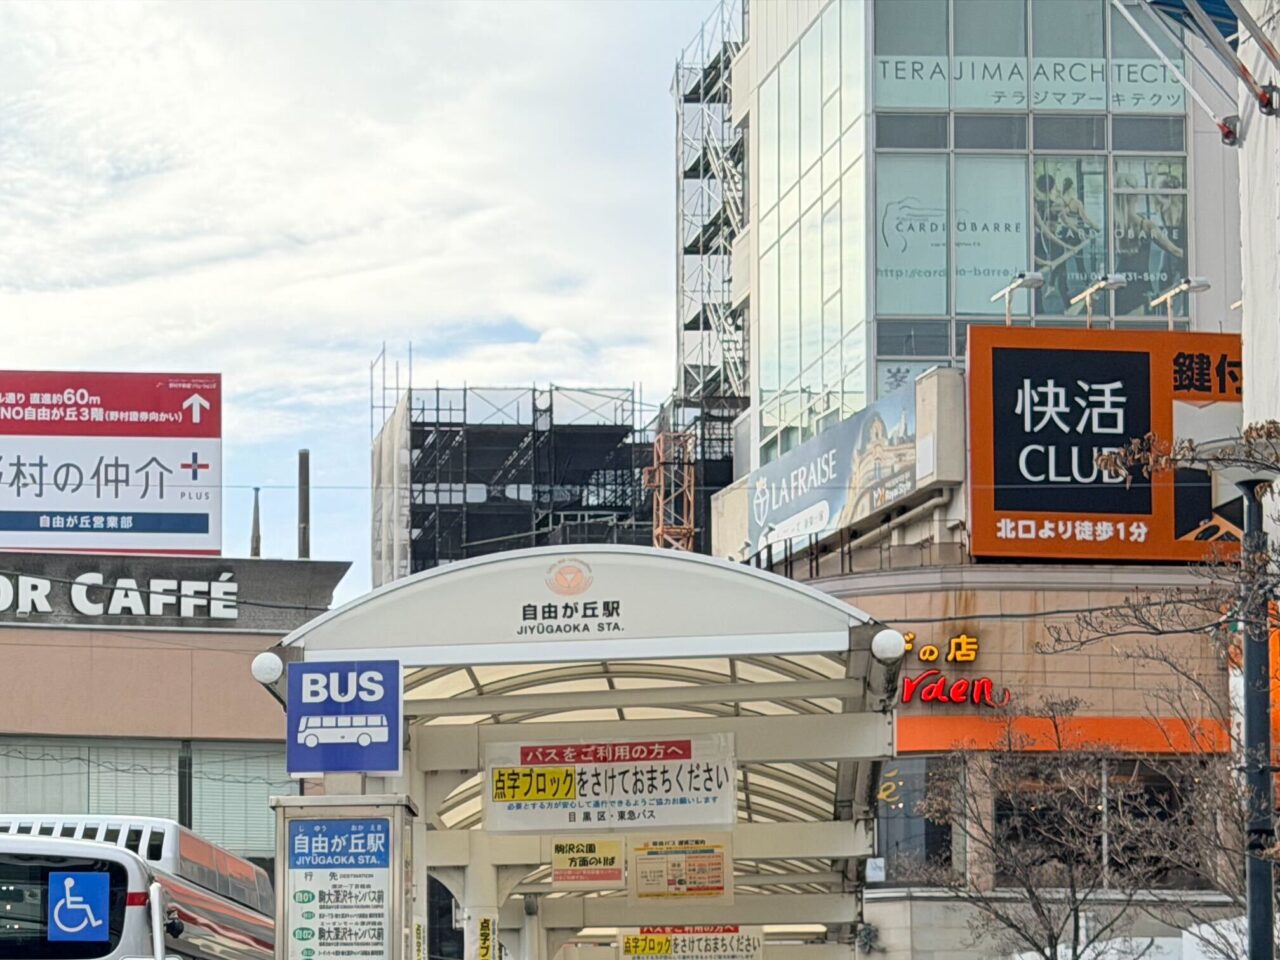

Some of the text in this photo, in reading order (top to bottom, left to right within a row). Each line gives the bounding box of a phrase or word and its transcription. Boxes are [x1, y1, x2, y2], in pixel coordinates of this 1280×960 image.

[880, 60, 1181, 84] TERAJIMA ARCHTECTS
[992, 90, 1181, 106] テラジマアーキテクツ
[30, 388, 101, 405] 直進約60m
[1014, 378, 1127, 434] 快活
[790, 448, 838, 500] FRAISE
[180, 491, 210, 500] PLUS
[39, 515, 133, 530] 自由が丘営業部
[997, 518, 1148, 543] 北口より徒歩1分
[70, 570, 239, 619] CAFFÉ
[522, 600, 620, 621] 自由が丘駅
[597, 622, 624, 633] STA.
[904, 632, 979, 663] の店
[302, 670, 384, 704] BUS
[526, 744, 684, 763] バスをご利用の方へ
[494, 762, 730, 799] 点字ブロックをさけておまちください
[294, 833, 385, 854] 自由が丘駅
[554, 843, 596, 854] 駒沢公園
[357, 855, 380, 865] STA.
[568, 856, 616, 867] 方面のりば
[624, 935, 761, 954] 点字ブロックをさけておまちください
